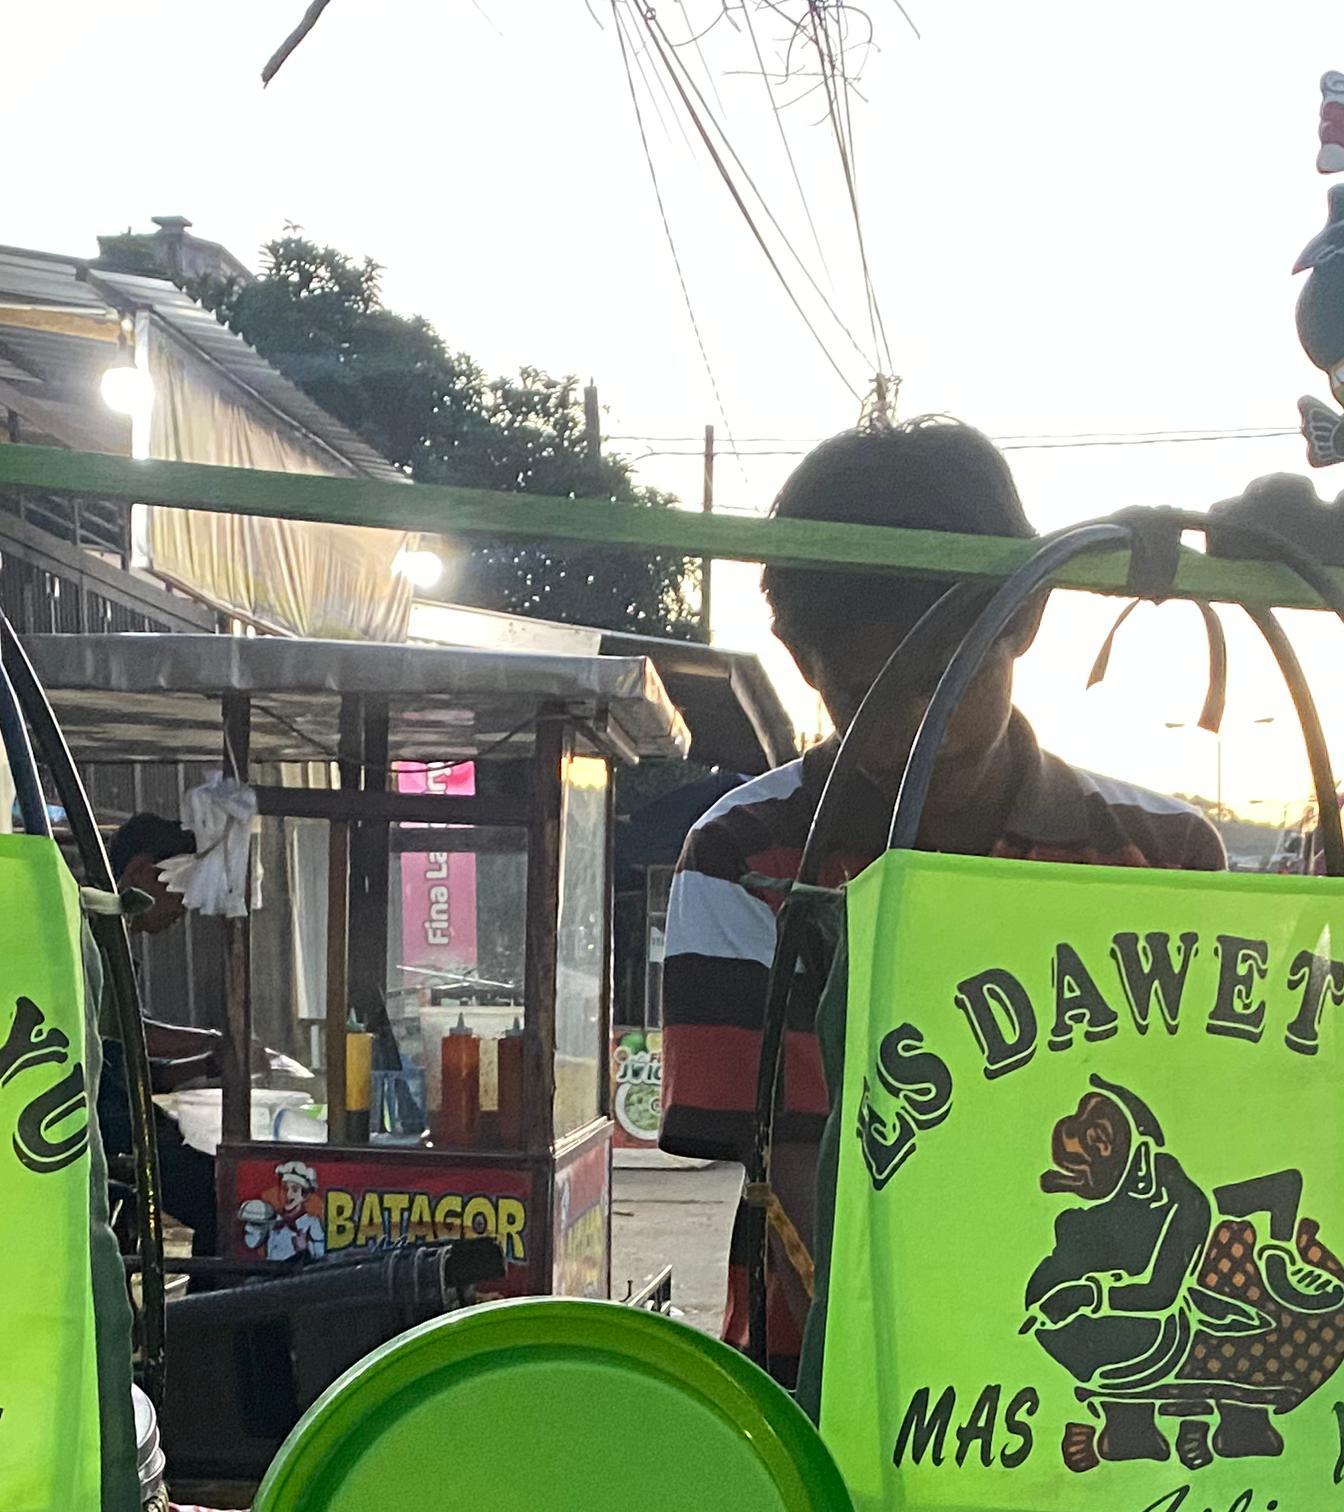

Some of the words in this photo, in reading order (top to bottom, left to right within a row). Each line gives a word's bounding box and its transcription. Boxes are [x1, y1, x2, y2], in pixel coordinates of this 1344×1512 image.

[424, 884, 450, 946] Fina
[856, 1021, 954, 1192] ES
[323, 1188, 527, 1264] BATAGOR
[892, 1383, 1041, 1469] MAS
